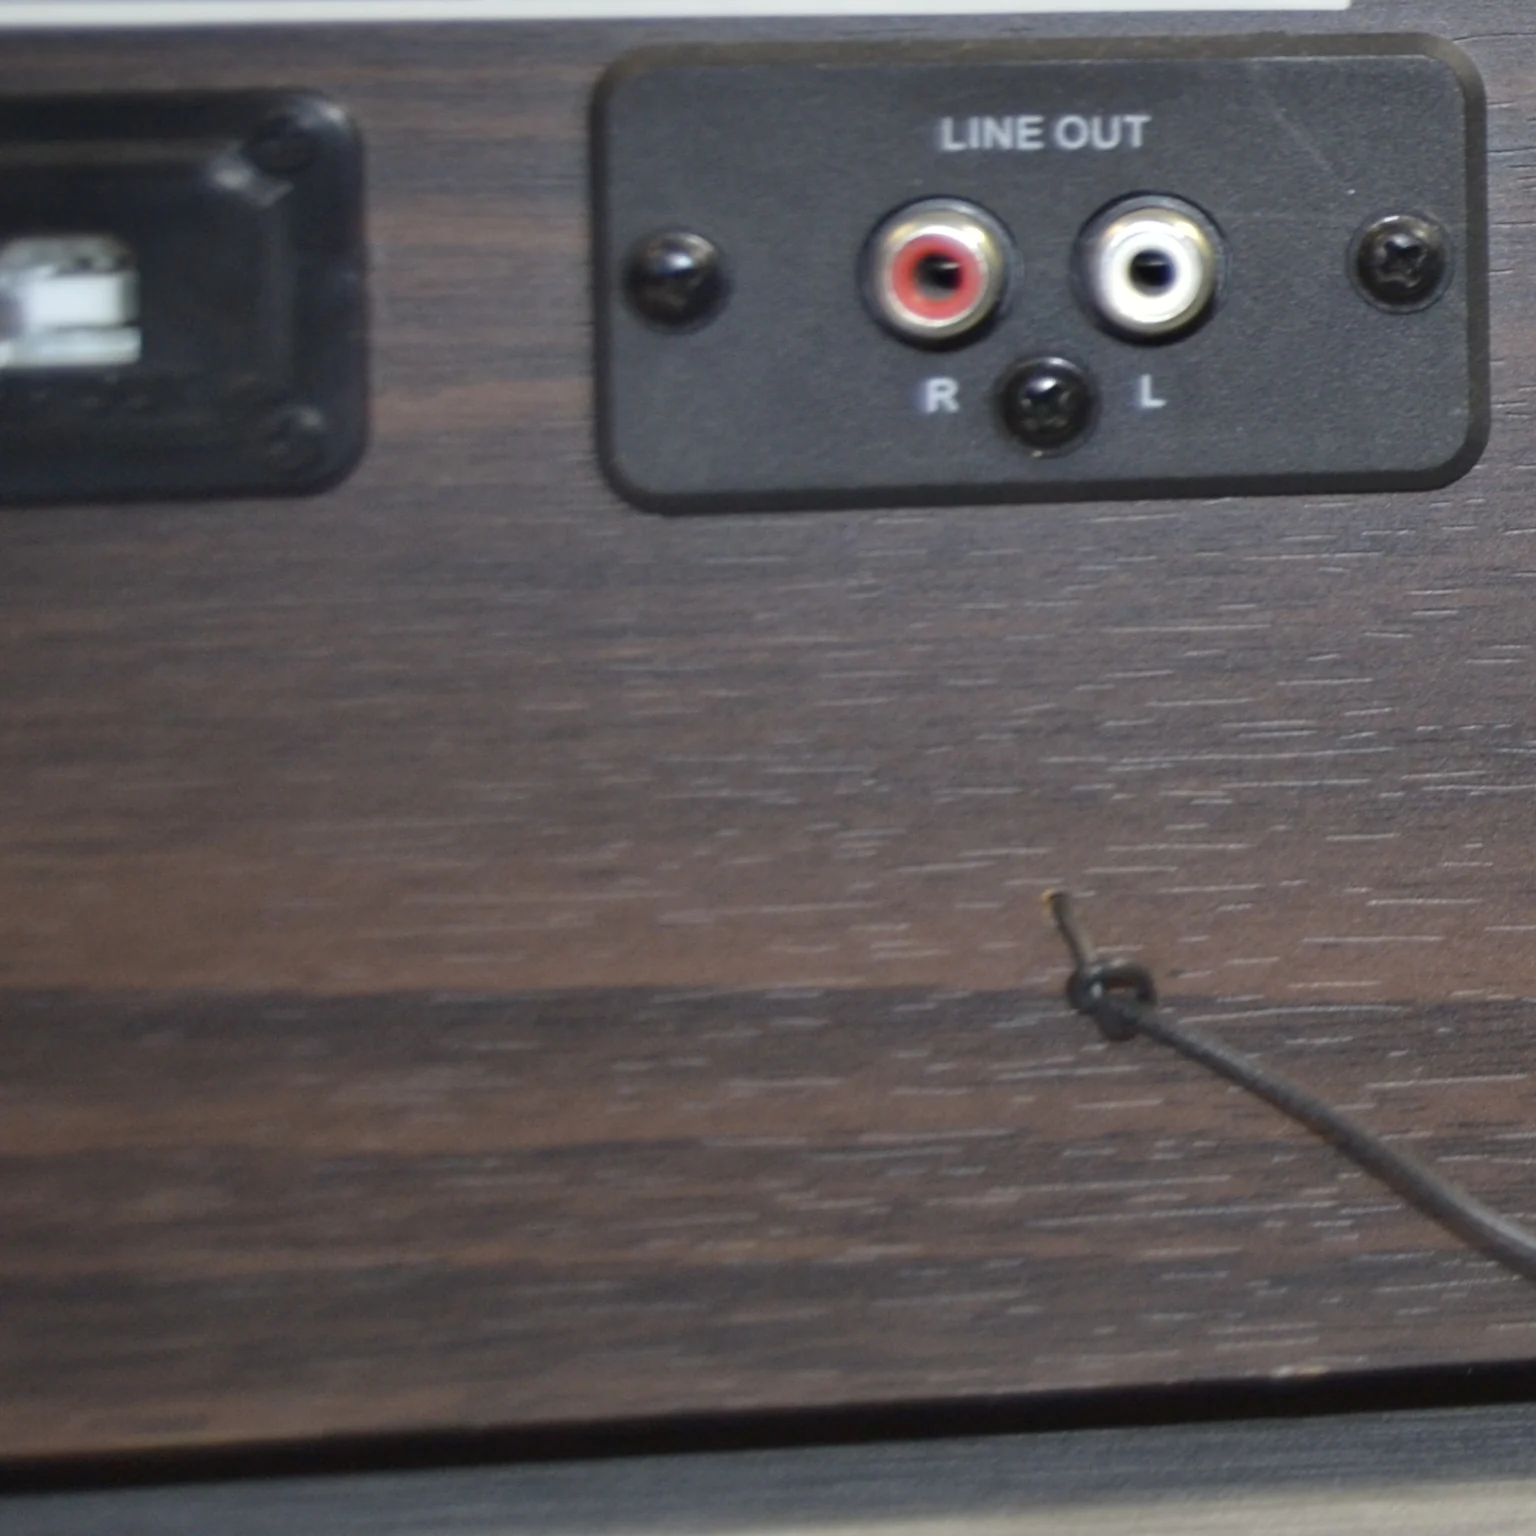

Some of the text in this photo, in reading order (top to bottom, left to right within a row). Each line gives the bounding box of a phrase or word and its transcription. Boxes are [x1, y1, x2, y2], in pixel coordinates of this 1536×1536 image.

[939, 114, 1149, 151] LINE OUT
[924, 377, 958, 412] R
[1138, 374, 1165, 408] L
